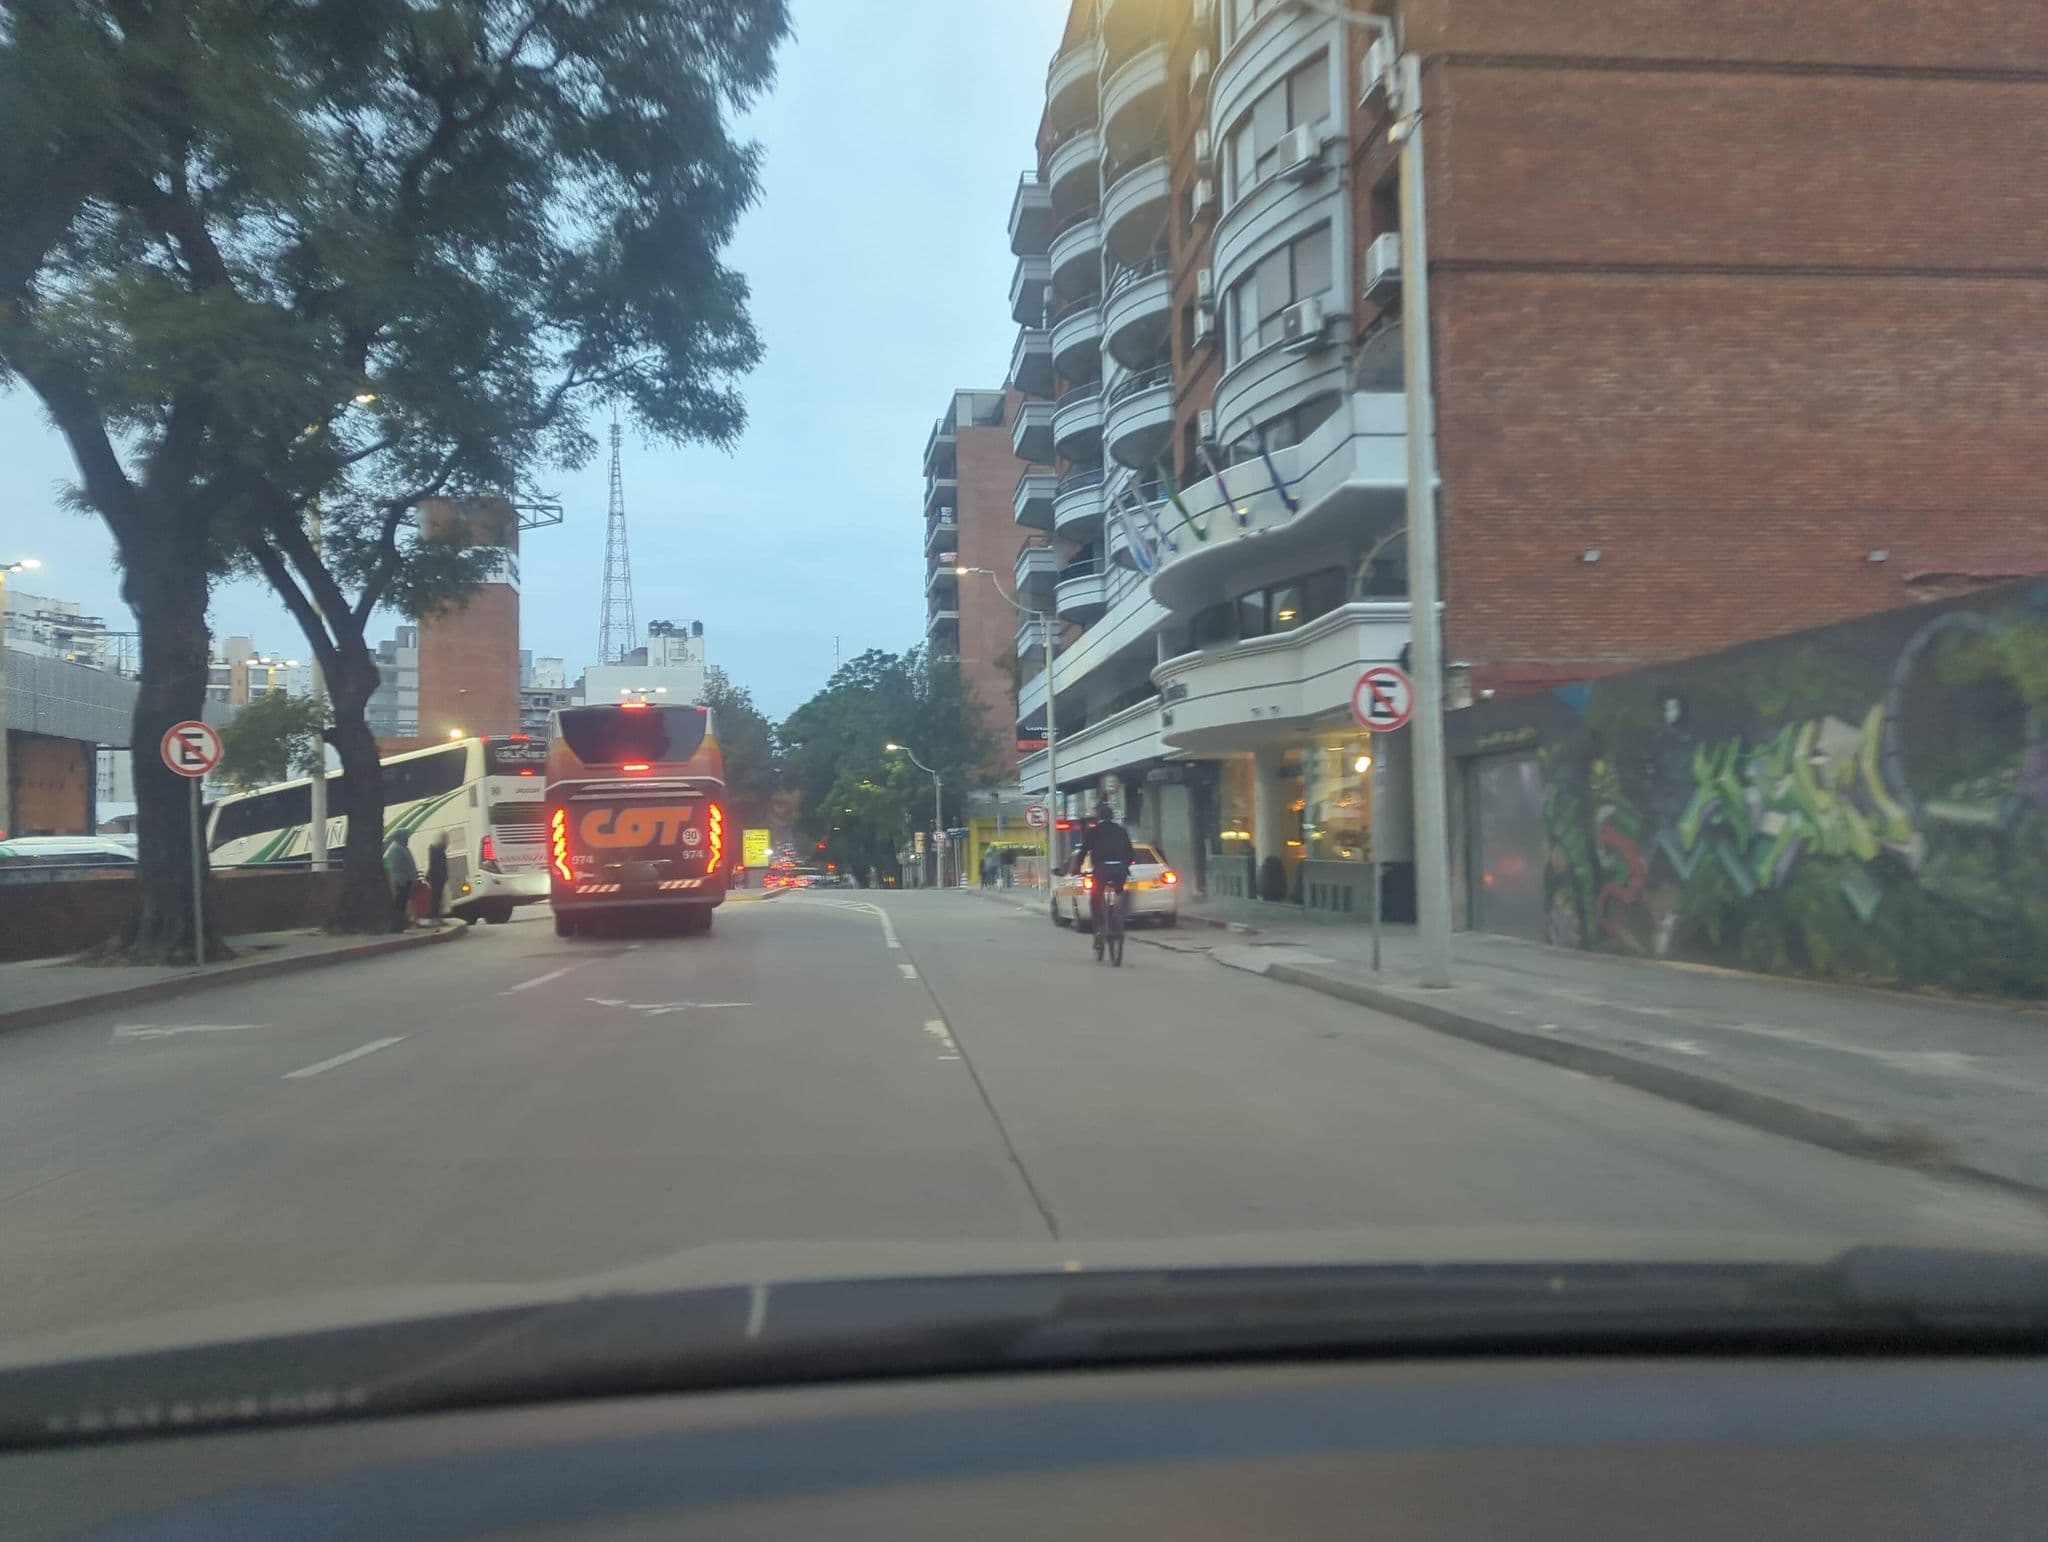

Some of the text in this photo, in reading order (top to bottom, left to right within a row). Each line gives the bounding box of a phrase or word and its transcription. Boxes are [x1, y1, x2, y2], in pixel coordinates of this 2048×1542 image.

[1369, 680, 1398, 718] E
[181, 733, 205, 765] E
[581, 807, 693, 848] COT
[684, 830, 698, 840] 90
[571, 855, 595, 865] 974
[683, 850, 704, 860] 974
